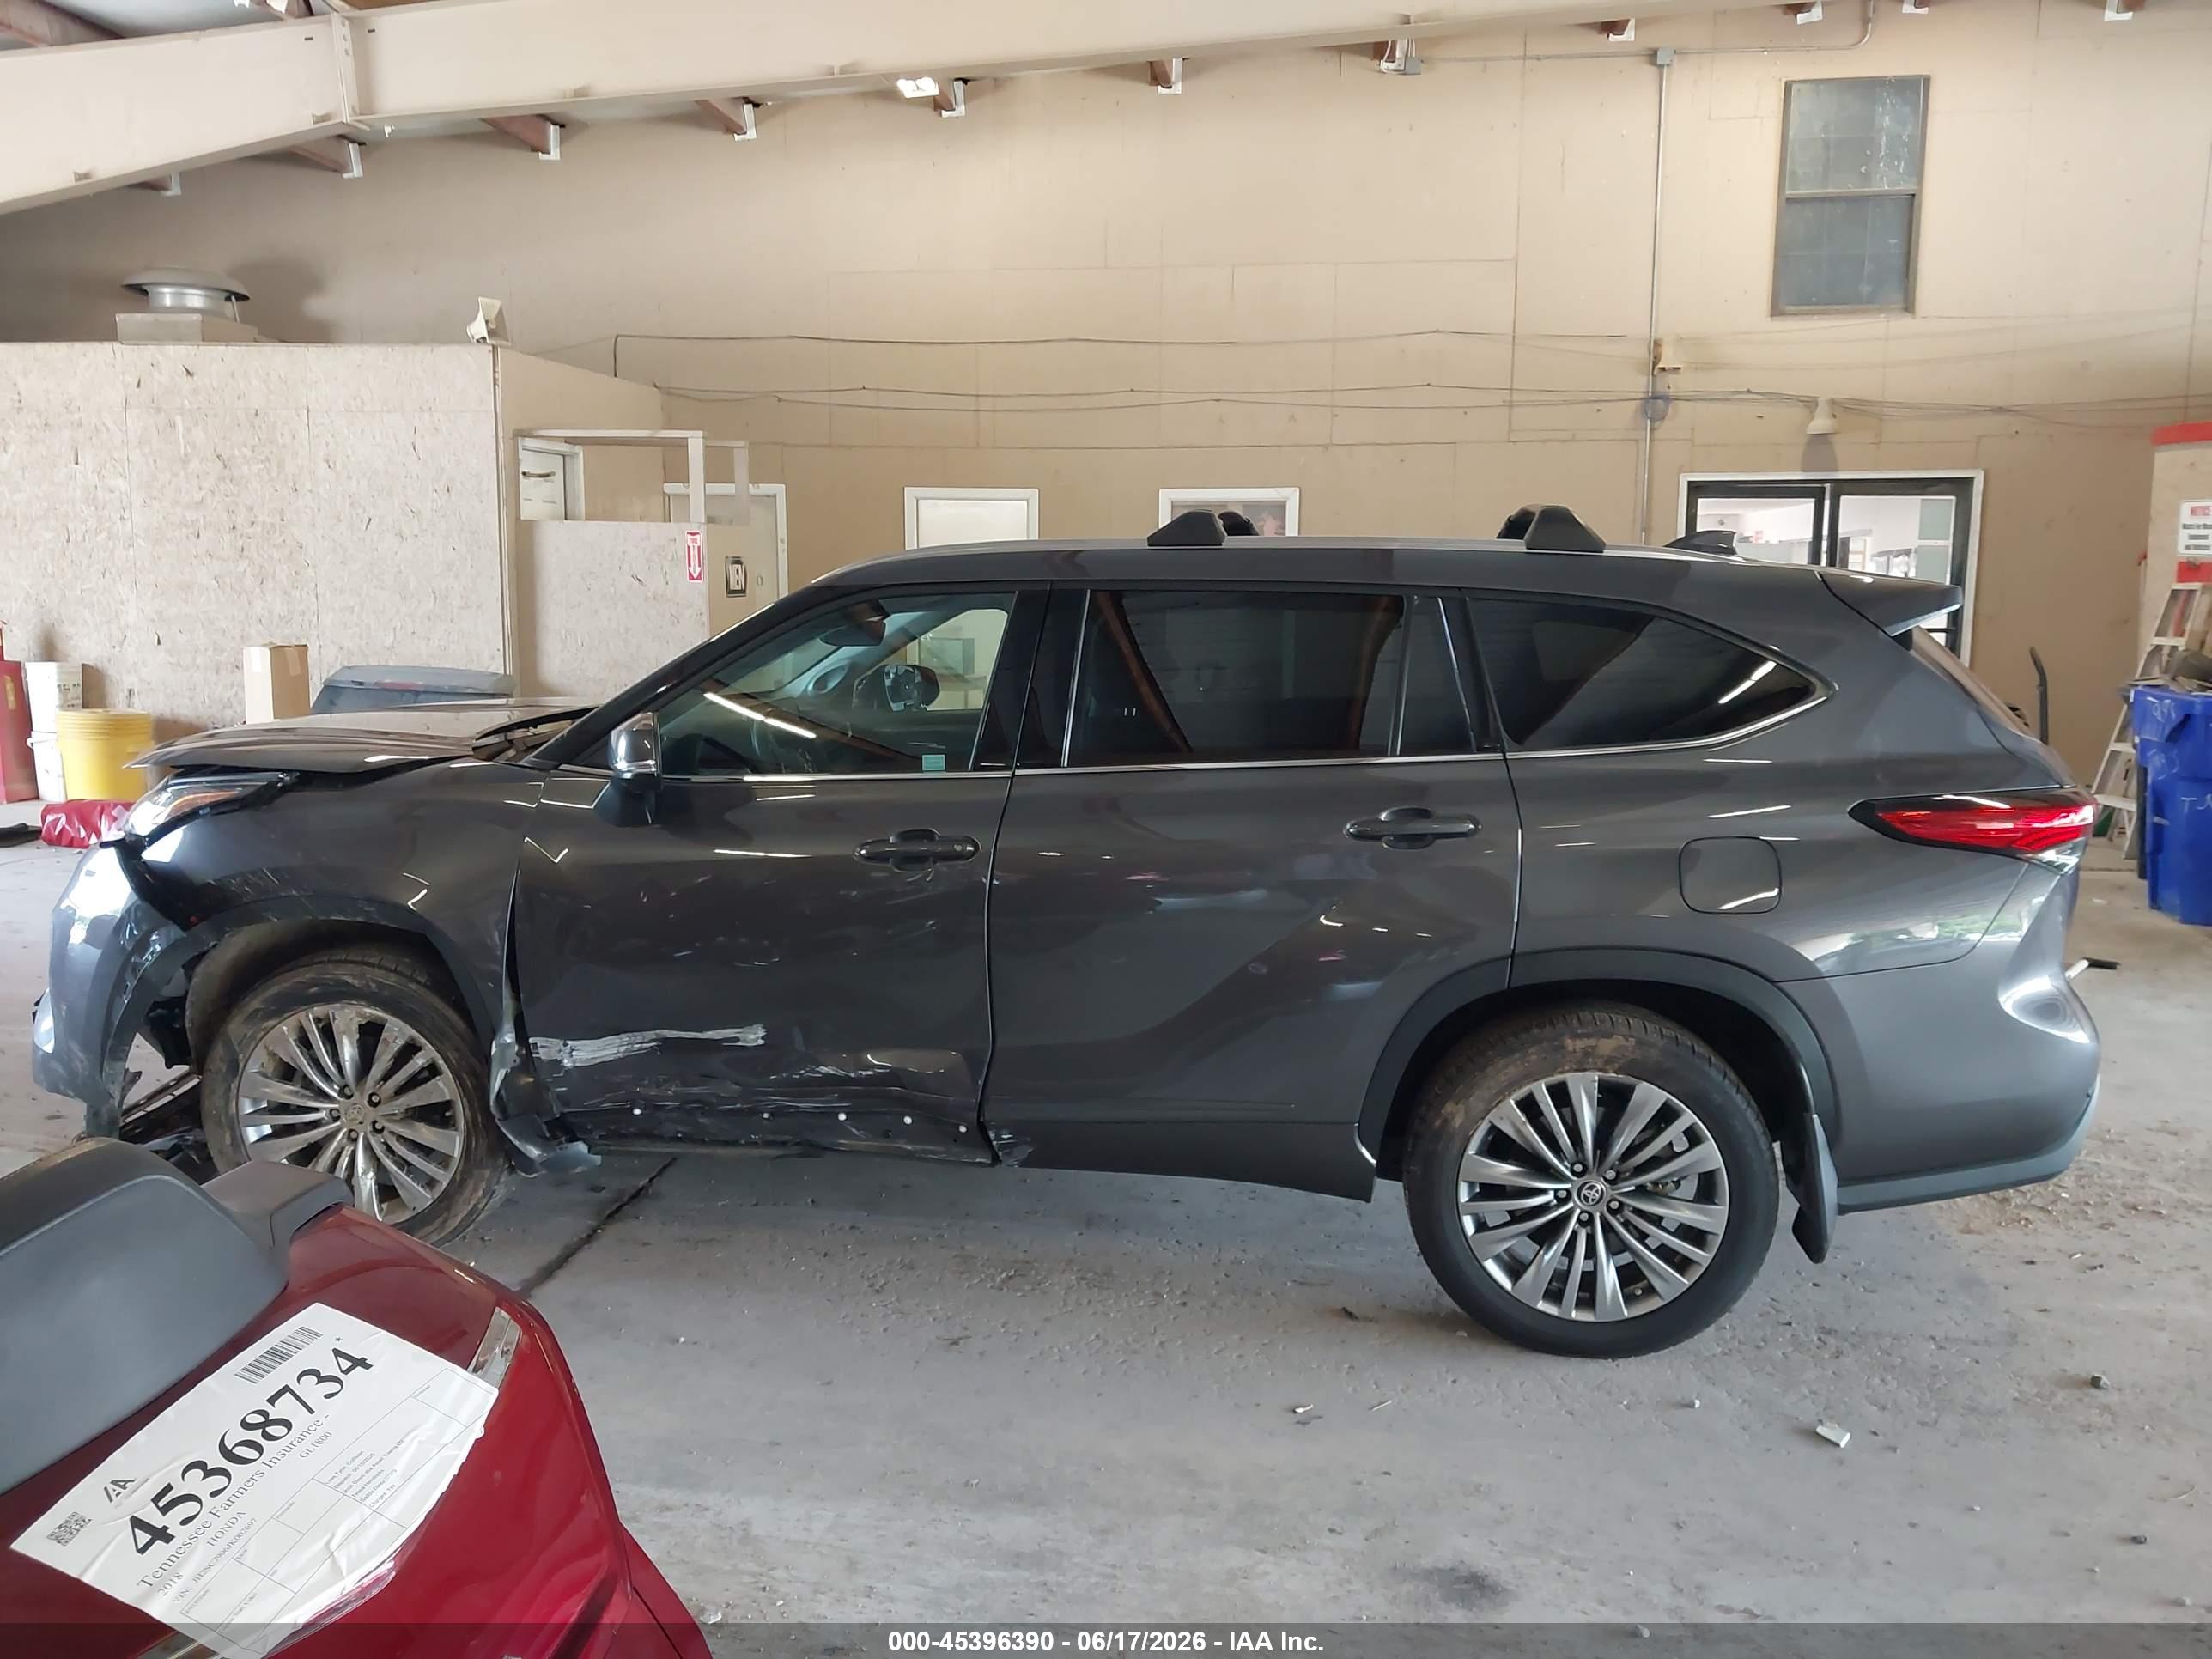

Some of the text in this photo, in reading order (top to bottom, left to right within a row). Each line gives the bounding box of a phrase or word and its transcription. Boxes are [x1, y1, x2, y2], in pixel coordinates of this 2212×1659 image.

[130, 1347, 374, 1555] 45368734
[137, 1519, 213, 1588] Tennessee
[208, 1469, 265, 1519] Farmers
[260, 1419, 324, 1468] Insurance
[158, 1431, 332, 1596] 2018 HONDA GL1800
